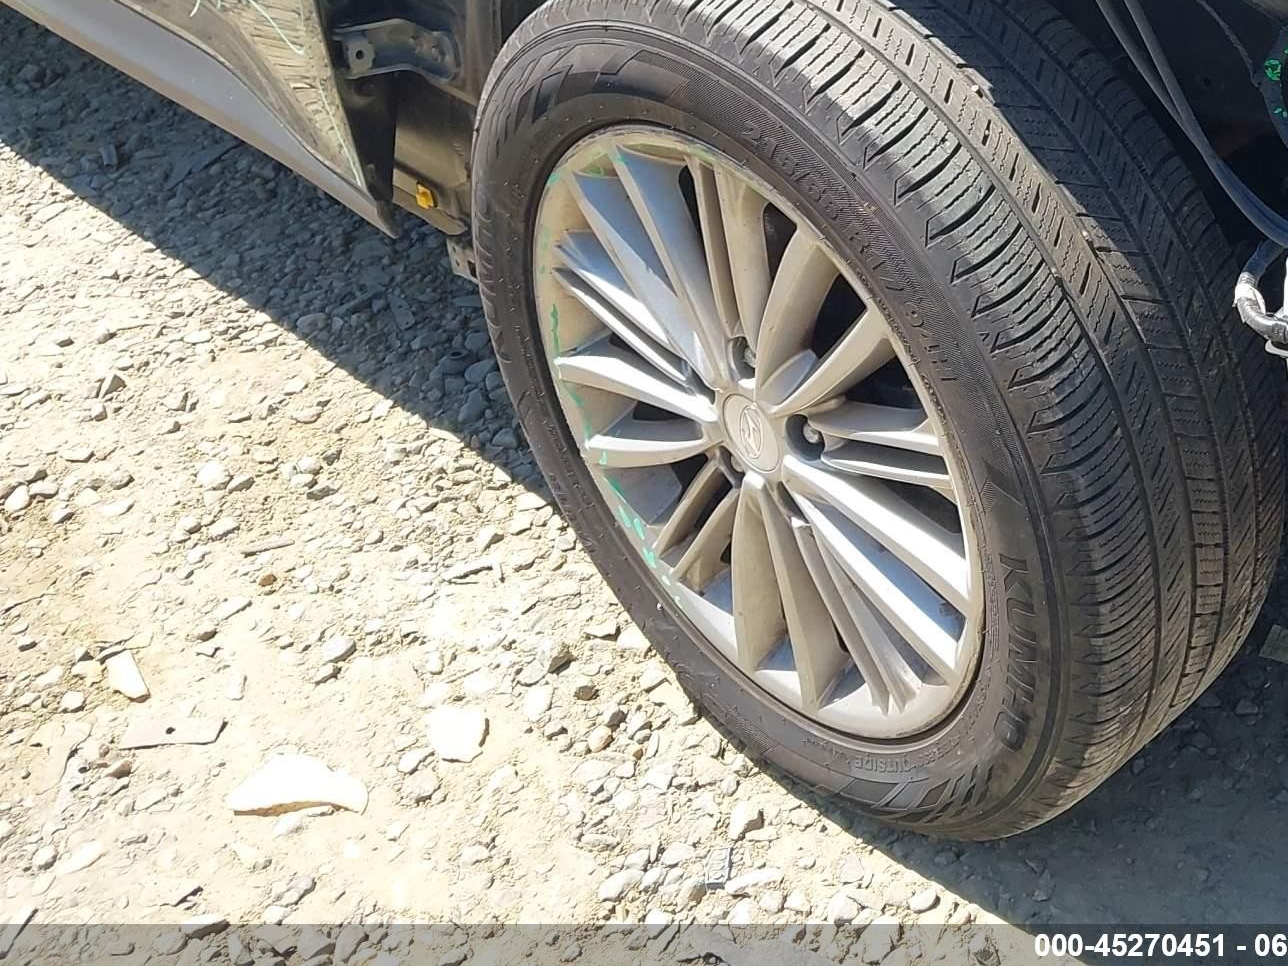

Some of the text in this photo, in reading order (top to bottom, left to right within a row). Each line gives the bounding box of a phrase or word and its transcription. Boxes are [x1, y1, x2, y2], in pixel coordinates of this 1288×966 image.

[850, 231, 906, 292] R17
[993, 553, 1039, 753] KUMHO
[854, 754, 914, 775] OUTSIDE
